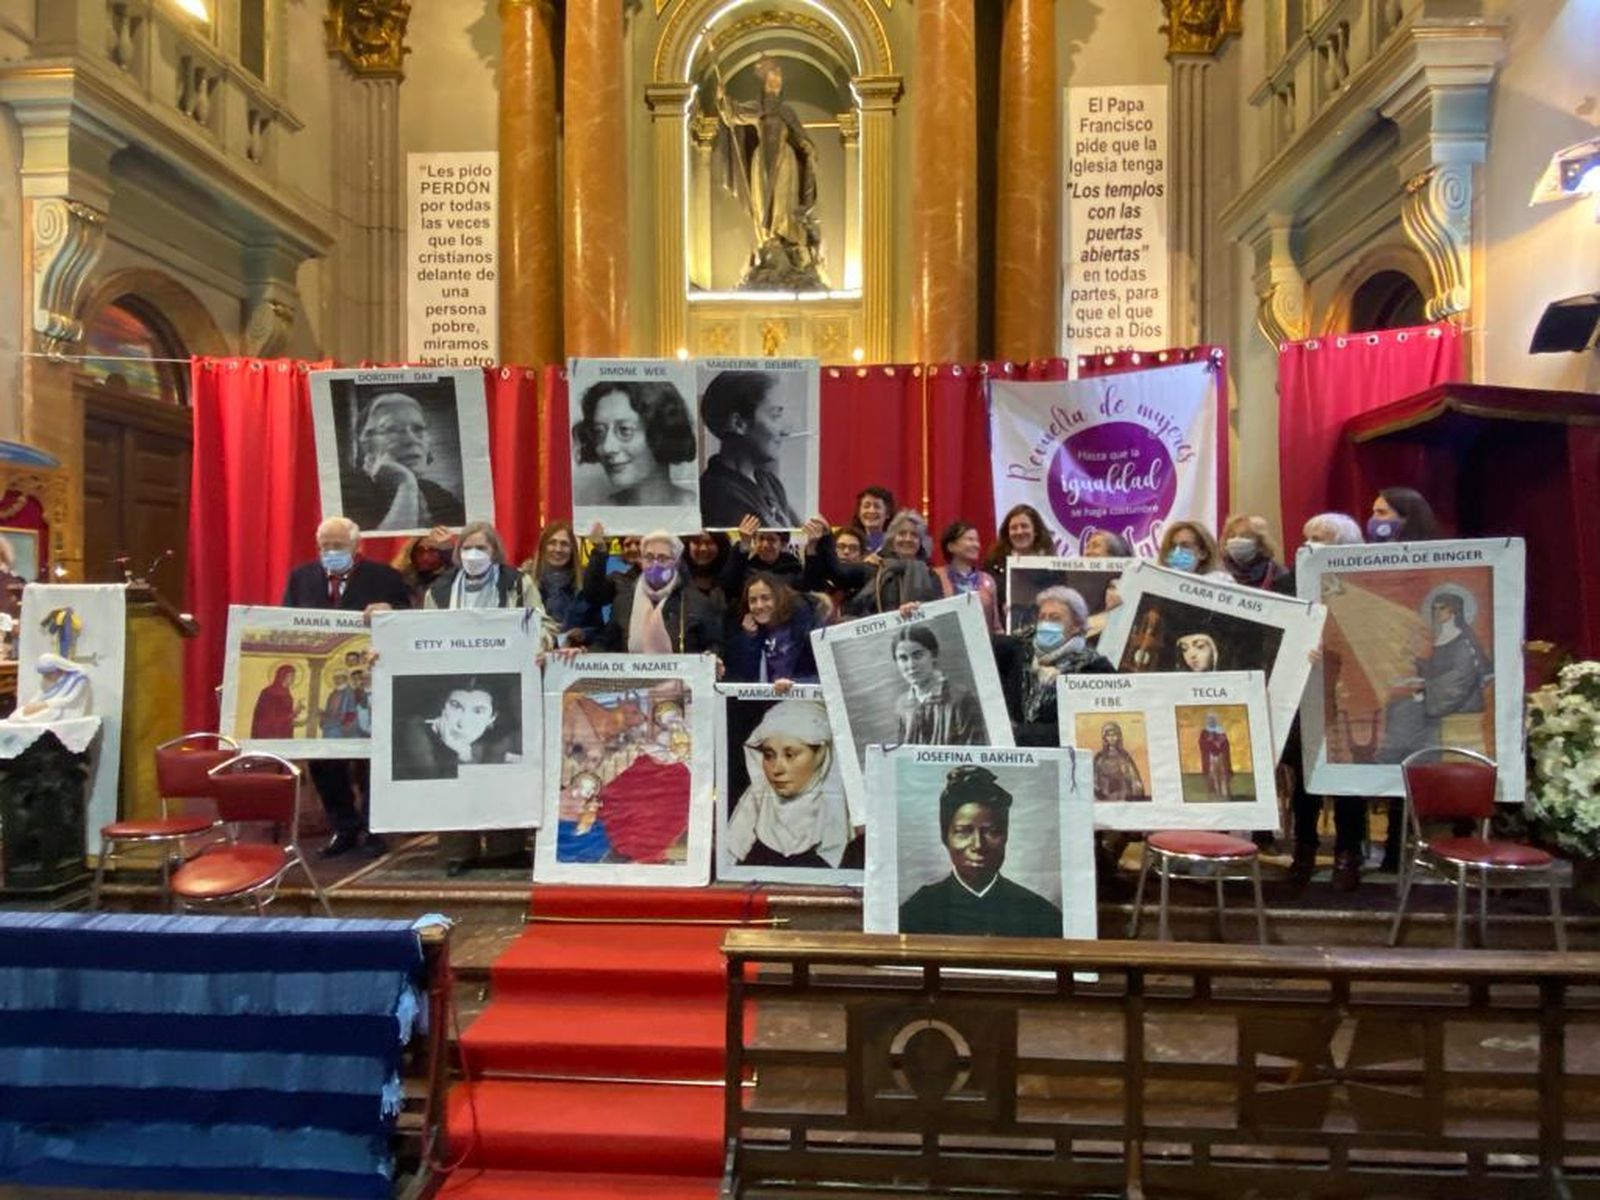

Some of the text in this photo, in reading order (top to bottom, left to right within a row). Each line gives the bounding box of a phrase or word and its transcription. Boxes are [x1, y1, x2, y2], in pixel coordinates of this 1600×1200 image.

[1088, 97, 1145, 115] El Papa
[1080, 117, 1153, 133] Francisco
[1076, 136, 1157, 157] pide que la
[459, 164, 492, 180] pido
[1069, 157, 1163, 177] Iglesia tenga
[420, 178, 490, 195] PERDÓN
[1105, 180, 1164, 201] templos
[420, 198, 491, 216] por todas
[1088, 202, 1142, 220] con las
[421, 217, 490, 230] las veces
[428, 234, 483, 249] que los
[1086, 226, 1143, 245] puertas
[418, 251, 493, 263] cristianos
[417, 268, 495, 281] delante de
[1083, 266, 1147, 282] en todas
[441, 287, 470, 298] una
[1071, 287, 1159, 304] partes, para
[426, 305, 487, 318] persona
[1076, 303, 1153, 322] que el que
[432, 320, 480, 335] pobre,
[1066, 321, 1163, 338] busca a Dios
[423, 338, 489, 351] miramos
[420, 354, 494, 367] hacia otro
[358, 370, 434, 382] DOROTHY DAY
[599, 366, 668, 376] SIMONE WEIL
[1007, 385, 1196, 483] Revuelta de mujeres
[1061, 458, 1162, 506] igualdad
[1051, 560, 1085, 569] TERESA
[1089, 561, 1102, 569] DE
[1327, 549, 1483, 568] HILDEGARDA DE BINGER
[1178, 583, 1214, 600] CLARA
[1218, 592, 1233, 605] DE
[855, 618, 888, 636] EDITH
[414, 637, 506, 650] ETTY HILLESUM
[612, 662, 625, 672] DE
[631, 661, 679, 672] NAZARET
[1068, 678, 1133, 691] DIACONISA
[1191, 687, 1229, 699] TECLA
[1094, 697, 1122, 708] FEBE
[916, 751, 1035, 763] JOSEFINA BAKHITA
